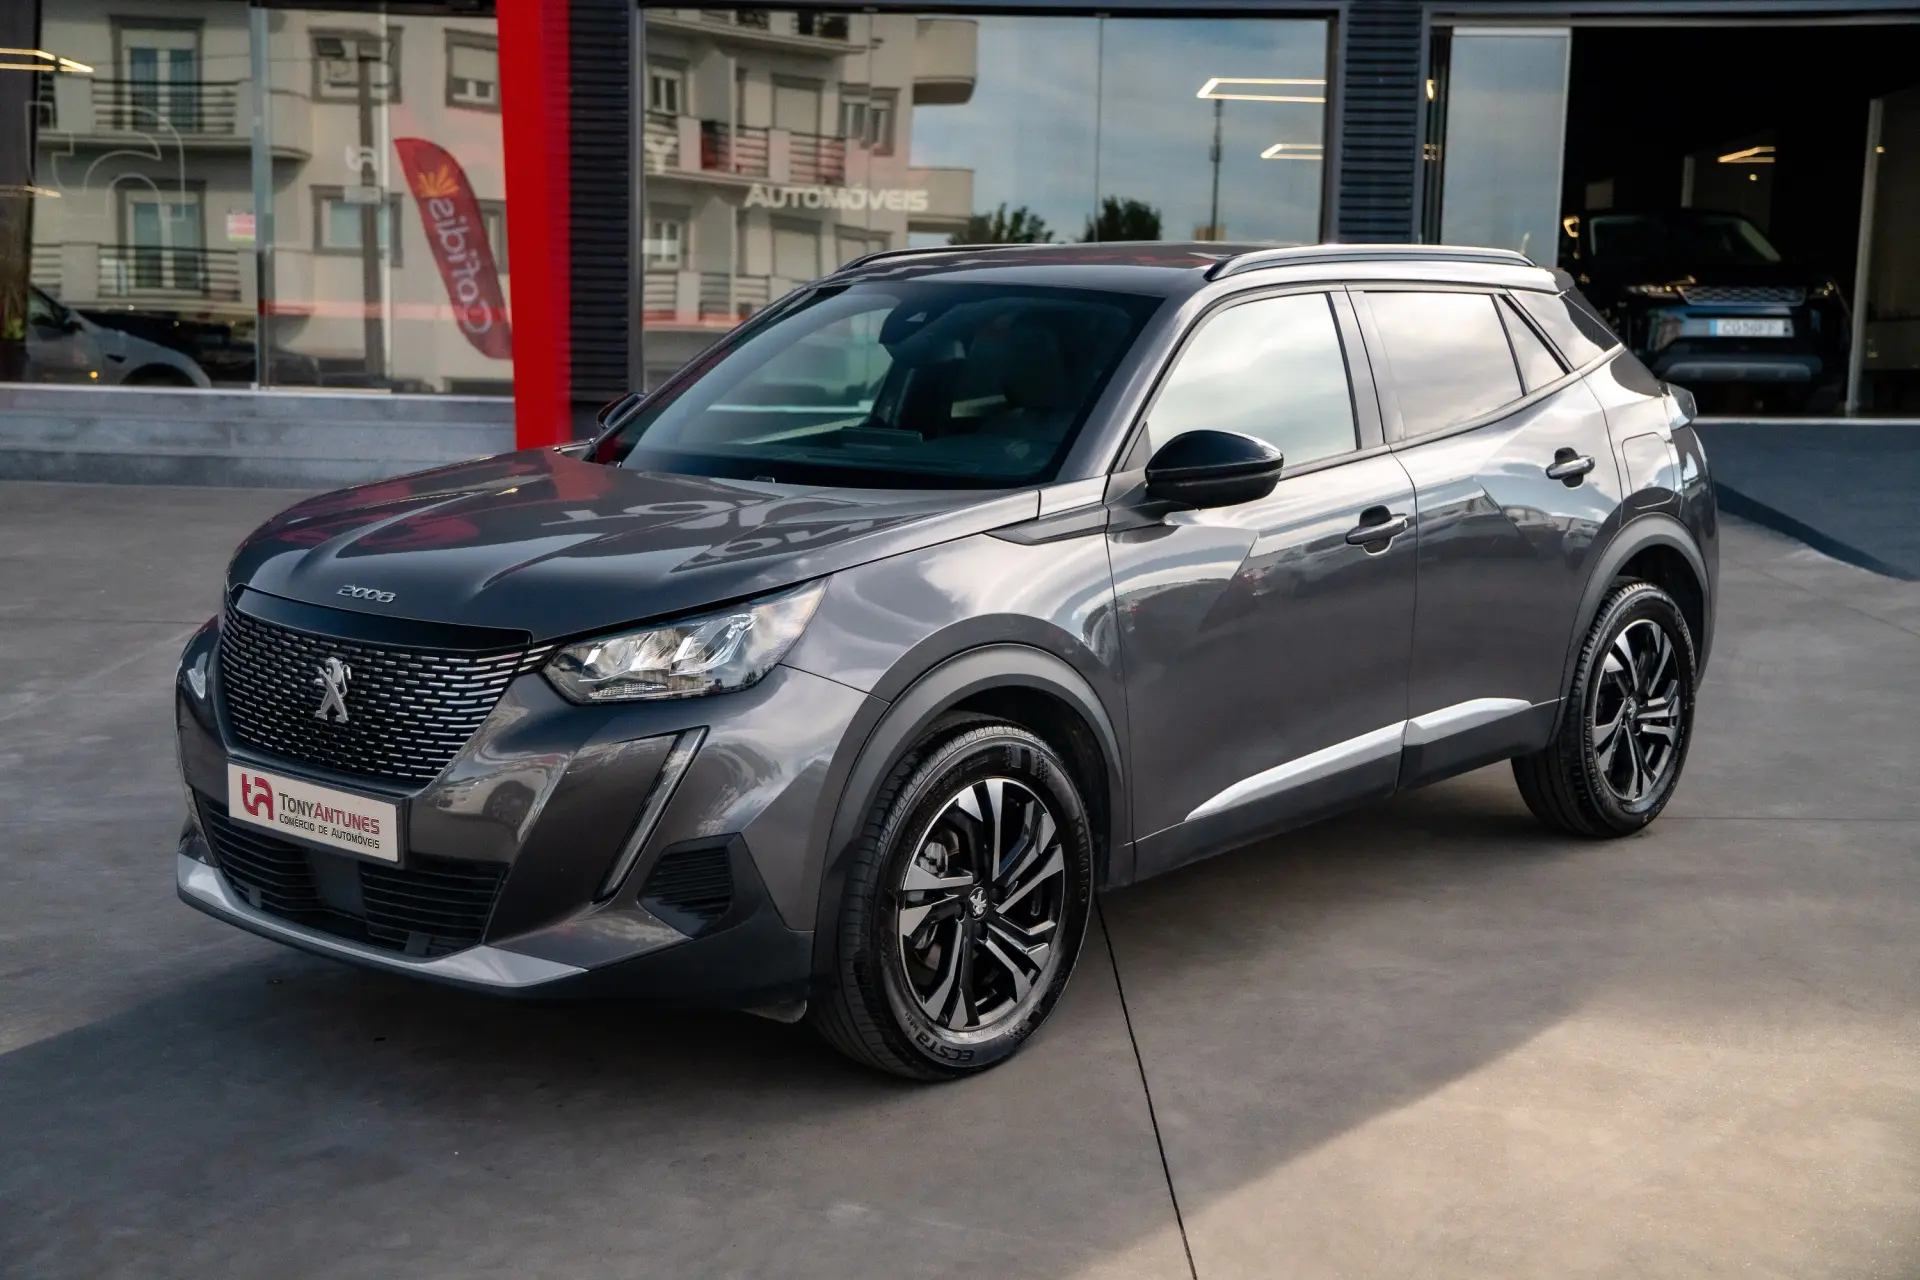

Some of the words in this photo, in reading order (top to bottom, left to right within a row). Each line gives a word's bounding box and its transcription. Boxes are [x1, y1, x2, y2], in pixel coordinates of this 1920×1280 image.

[744, 182, 929, 212] AUTOMÓVEIS
[336, 584, 397, 603] 2008
[279, 813, 315, 832] COMÉRCIO
[318, 824, 328, 836] DE
[331, 828, 380, 849] AUTOMÓVEIS
